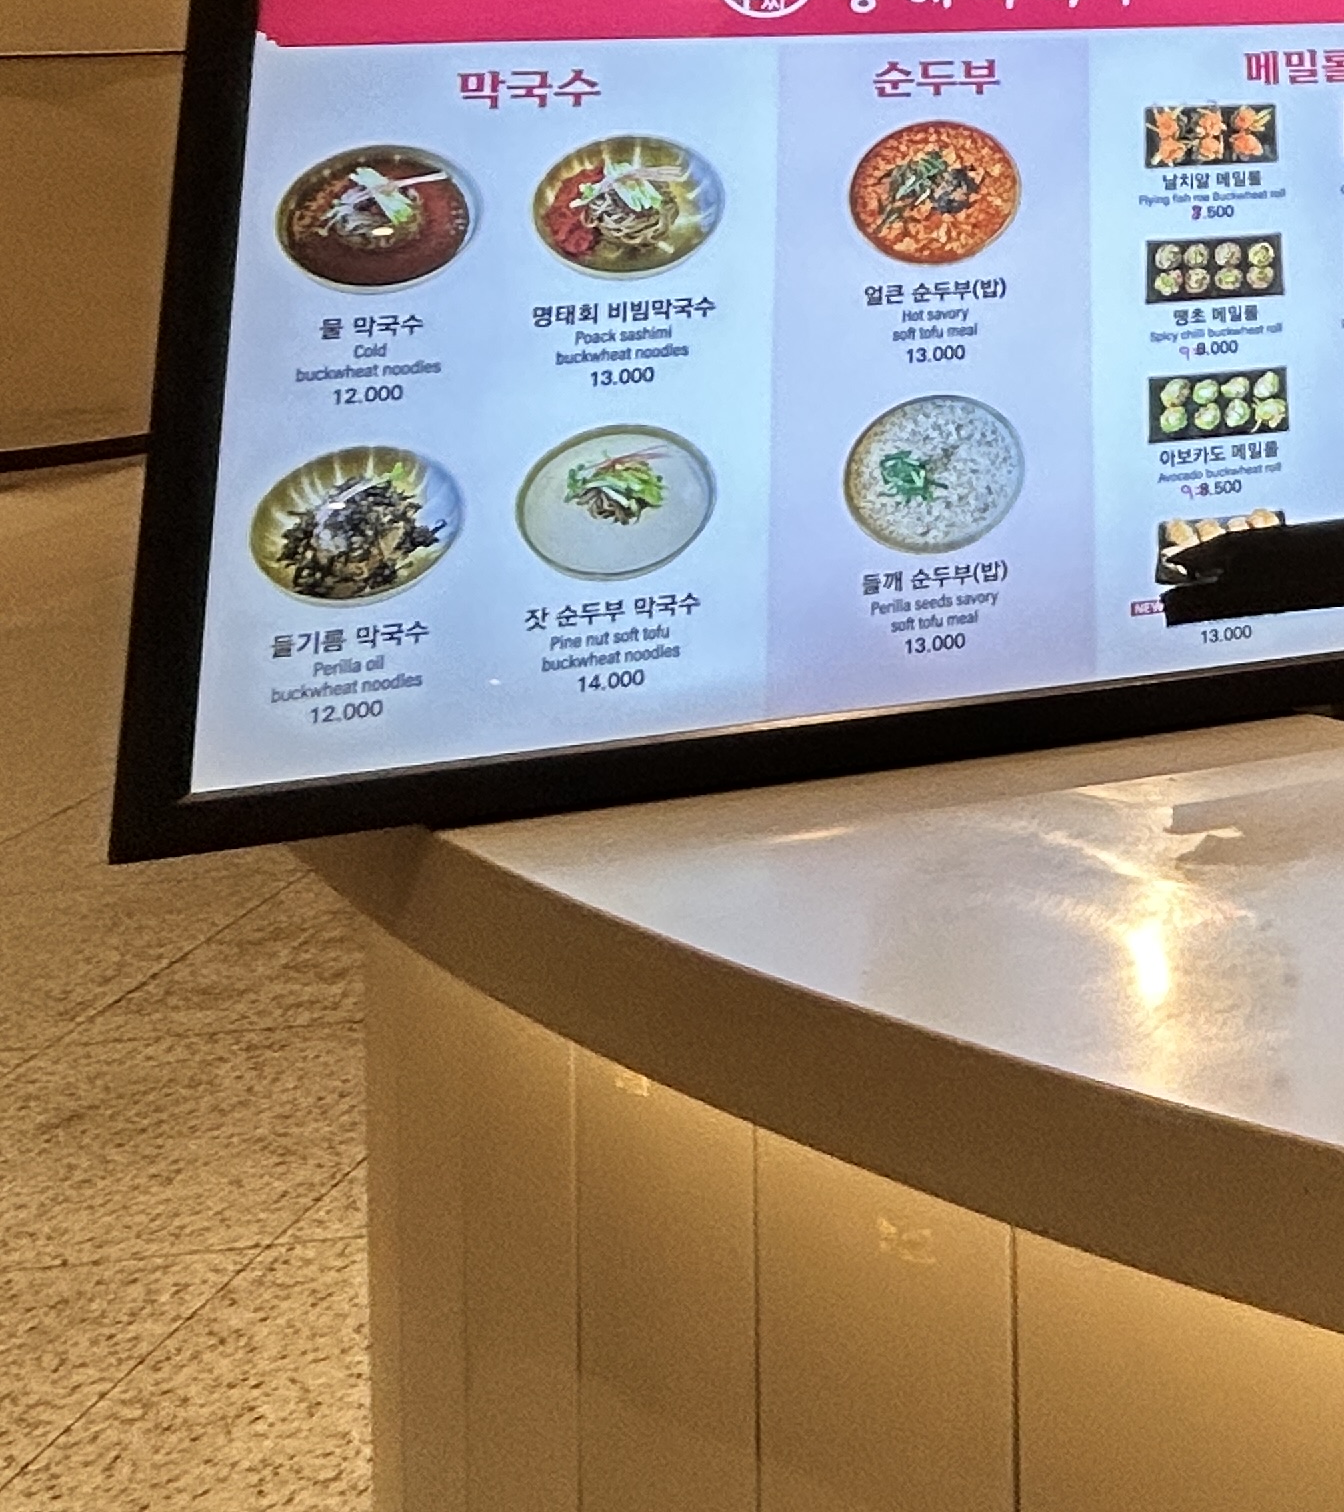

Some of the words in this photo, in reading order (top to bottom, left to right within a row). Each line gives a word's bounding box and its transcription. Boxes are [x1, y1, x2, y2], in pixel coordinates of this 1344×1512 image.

[457, 68, 602, 109] 막국수
[873, 58, 1001, 98] 순두부
[1162, 172, 1211, 191] 날치알
[864, 284, 905, 307] 얼큰
[911, 276, 1008, 305] 순두부(밥)
[532, 303, 600, 328] 명태회
[607, 295, 717, 322] 비빔막국수
[902, 309, 924, 324] Hot
[926, 307, 970, 323] savory
[319, 315, 344, 341] 물
[353, 313, 425, 338] 막국수
[619, 325, 673, 343] sashimi
[892, 328, 916, 342] soft
[918, 325, 944, 340] tofu
[947, 322, 979, 338] meal
[353, 342, 389, 360] Cold
[556, 347, 632, 367] buckwheat
[634, 342, 690, 361] noodles
[906, 344, 967, 364] 13.000
[295, 363, 379, 384] buckwheat
[382, 360, 442, 379] noodles
[590, 366, 656, 387] 13.000
[332, 384, 404, 406] 12.000
[1159, 446, 1226, 467] 아보카도
[1231, 440, 1280, 461] 메밀롤
[1158, 468, 1204, 483] Avocado
[862, 570, 904, 596] 들깨
[910, 559, 1009, 591] 순두부(밥)
[555, 599, 627, 629] 순두부
[633, 592, 701, 621] 막국수
[870, 599, 912, 616] Perilla
[914, 594, 953, 611] seeds
[955, 590, 1000, 607] savory
[890, 618, 916, 633] soft
[917, 615, 944, 630] tofu
[946, 610, 979, 626] meal
[1200, 624, 1253, 643] 13.000
[270, 626, 346, 660] 들기름
[355, 620, 430, 647] 막국수
[549, 634, 582, 652] Pine
[585, 630, 609, 648] nut
[612, 627, 640, 645] soft
[642, 624, 671, 644] tofu
[904, 632, 967, 654] 13.000
[312, 657, 362, 678] Perilla
[364, 655, 385, 672] oil
[541, 650, 620, 674] buckwheat
[624, 644, 681, 666] noodles
[270, 680, 358, 704] buckwheat
[360, 672, 424, 694] noodles
[577, 669, 646, 694] 14.000
[310, 699, 384, 725] 12.000
